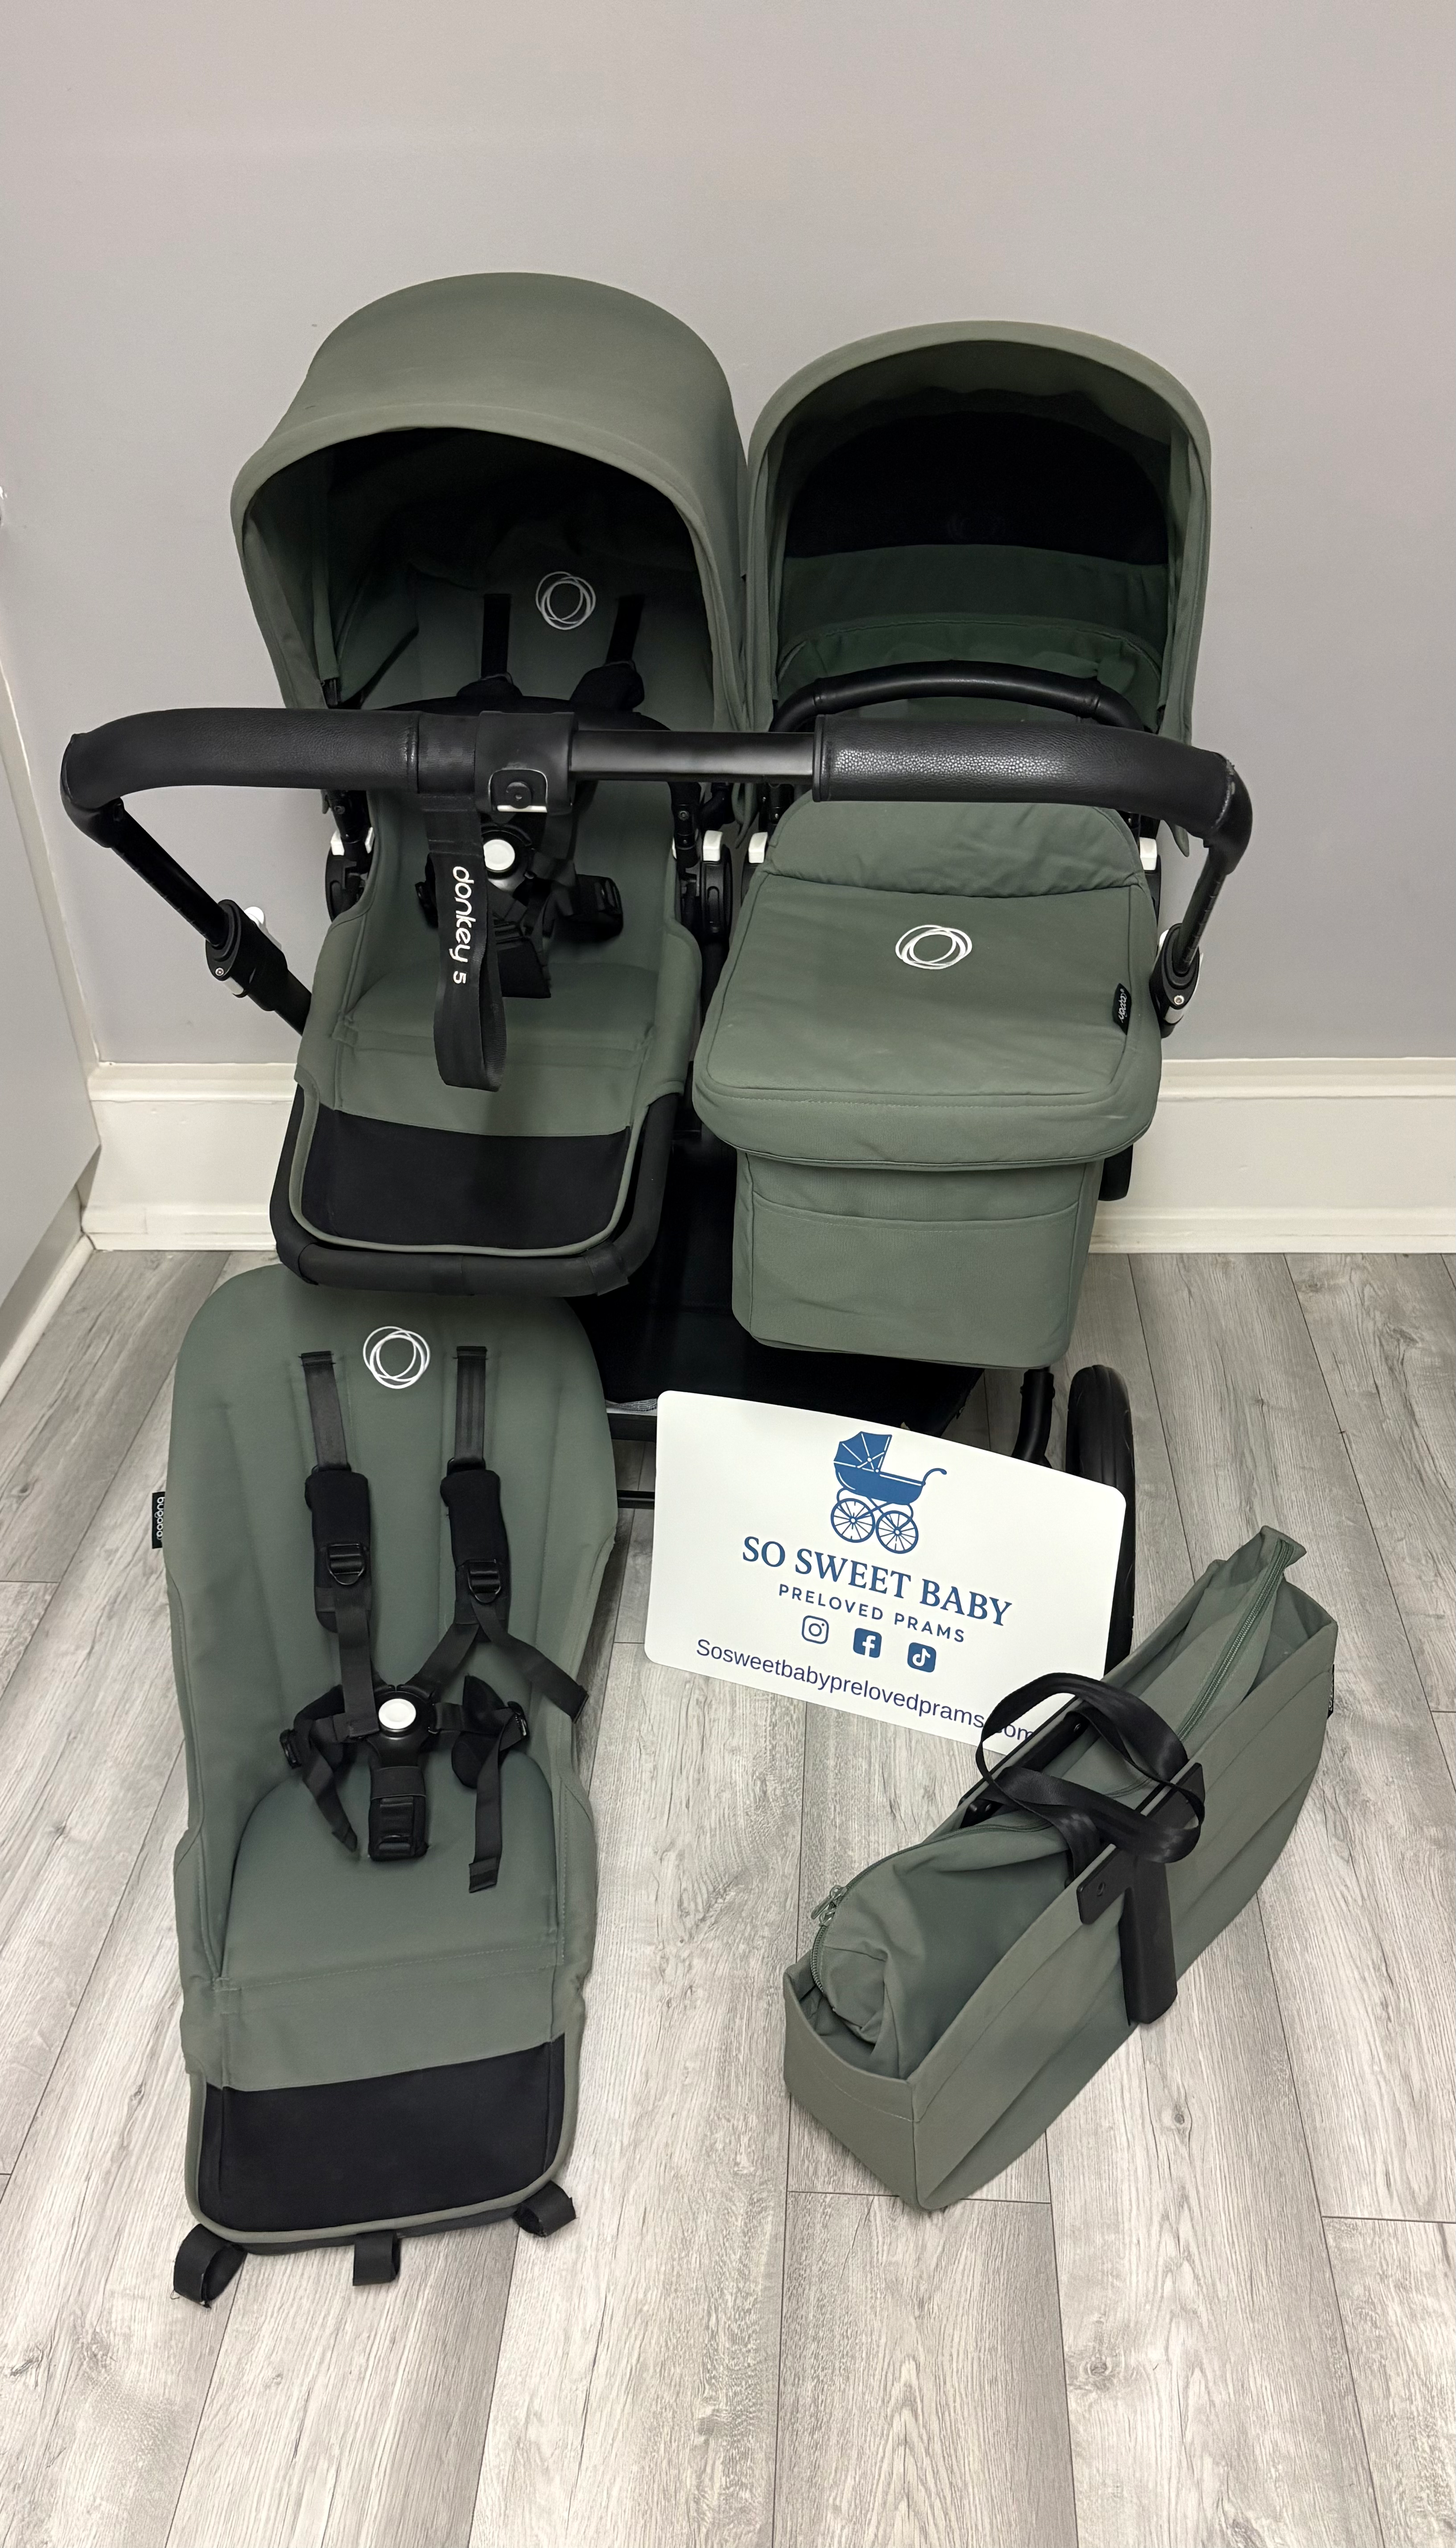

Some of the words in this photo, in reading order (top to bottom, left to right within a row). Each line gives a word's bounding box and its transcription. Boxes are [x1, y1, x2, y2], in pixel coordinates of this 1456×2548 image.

[449, 866, 476, 963] donkey
[453, 970, 466, 984] 5
[742, 1536, 785, 1568] SO
[795, 1548, 912, 1599] SWEET
[920, 1578, 1013, 1626] BABY
[779, 1584, 883, 1620] PRELOVED
[894, 1612, 965, 1642] PRAMS
[696, 1639, 1034, 1740] Sosweetbabyprelovedpramsom
